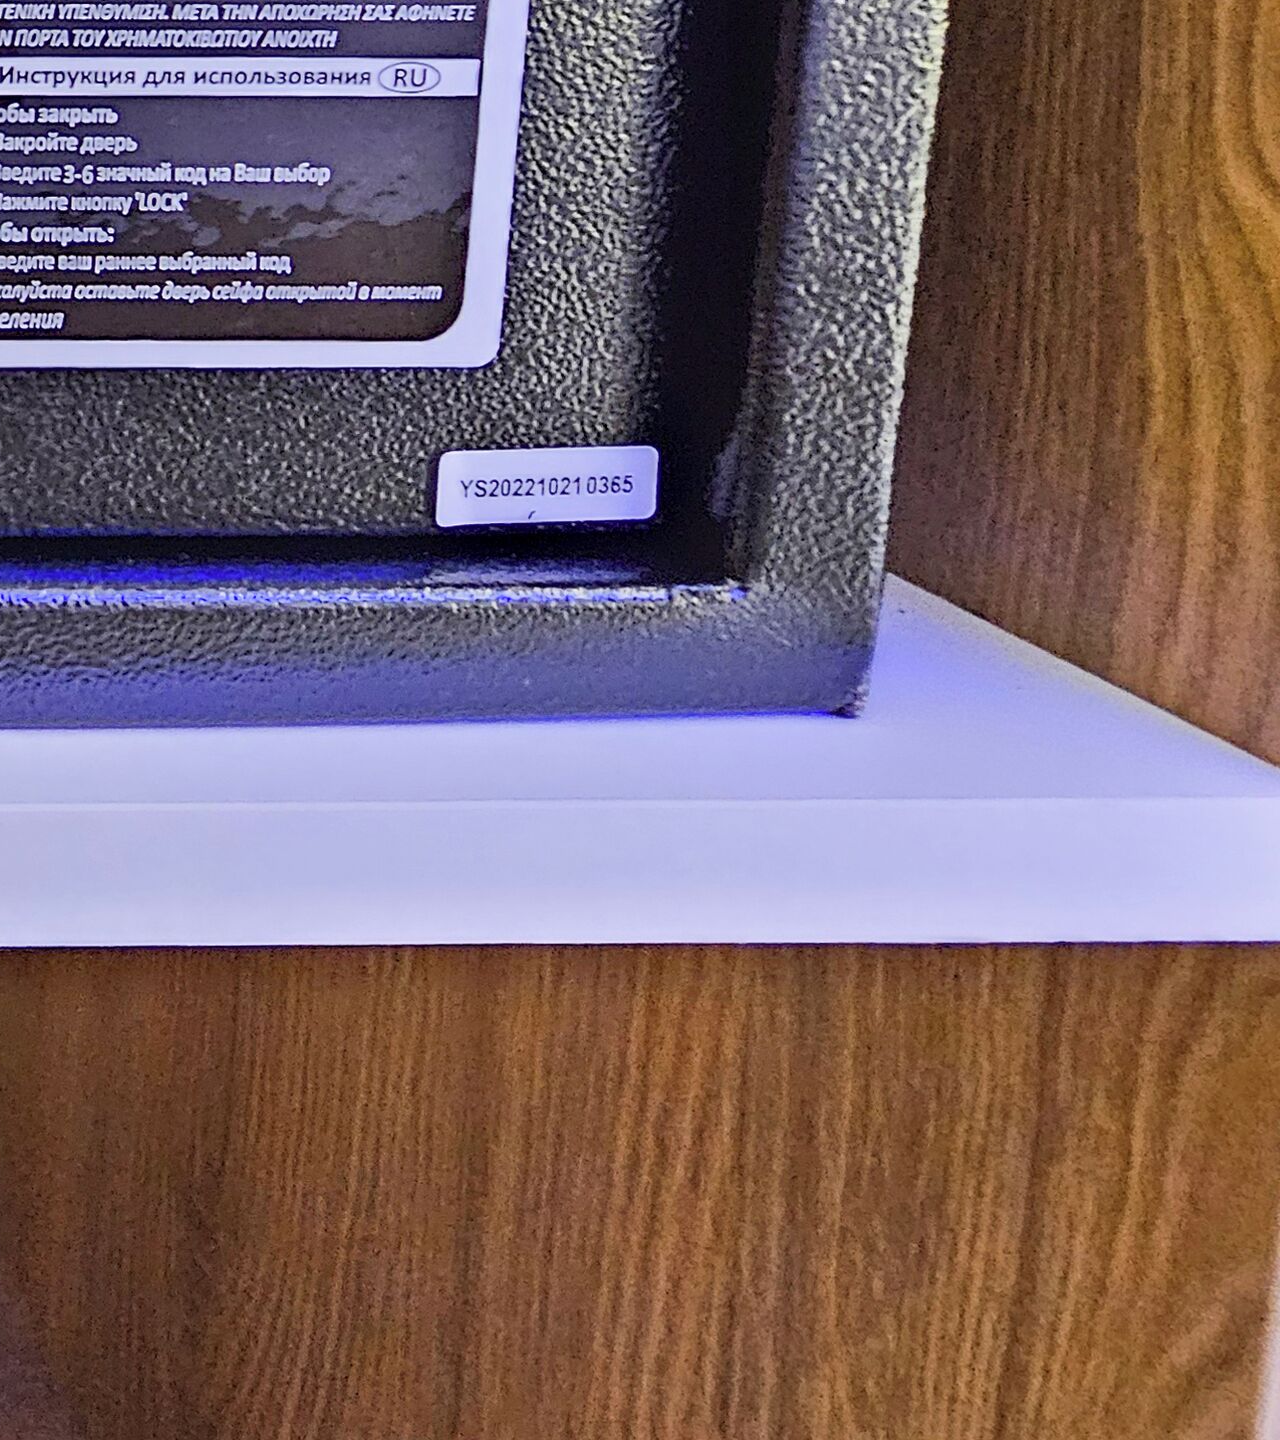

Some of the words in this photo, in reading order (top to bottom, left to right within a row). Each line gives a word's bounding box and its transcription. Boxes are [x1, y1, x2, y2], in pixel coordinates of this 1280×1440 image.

[0, 66, 135, 88] Инструкция
[142, 71, 185, 88] для
[194, 71, 371, 85] использования
[393, 68, 428, 88] RU
[38, 108, 118, 126] закрыть
[80, 136, 138, 155] дверь
[62, 164, 94, 184] 3-6
[174, 166, 207, 186] код
[209, 167, 230, 182] на
[234, 163, 271, 182] Ваш
[274, 162, 331, 186] выбор
[71, 196, 132, 214] кнопку
[30, 226, 114, 246] открыть:
[58, 256, 92, 270] ваш
[94, 255, 156, 274] раннее
[260, 256, 292, 274] код
